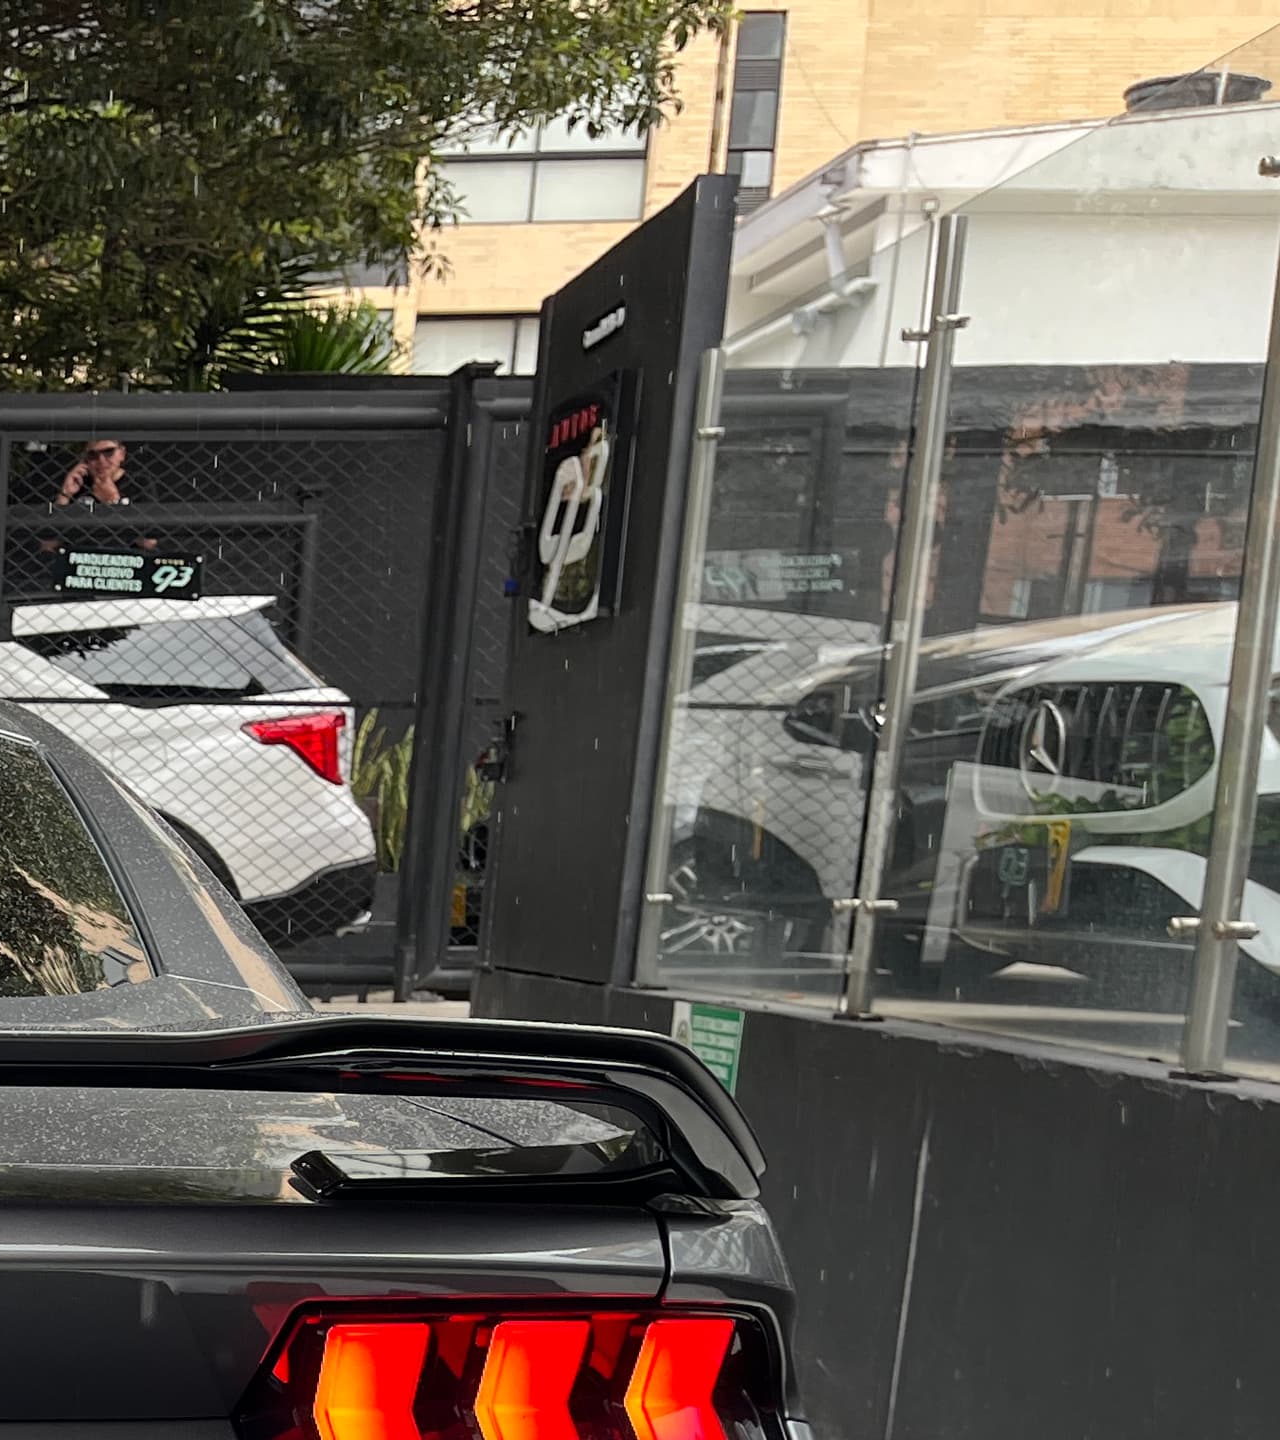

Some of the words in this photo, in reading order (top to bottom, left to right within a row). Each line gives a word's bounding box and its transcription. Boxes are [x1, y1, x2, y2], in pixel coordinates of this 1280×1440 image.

[76, 564, 134, 579] EXCLUSIVO
[151, 565, 194, 593] 93
[65, 575, 93, 589] PARA
[93, 577, 142, 592] CLIENTES
